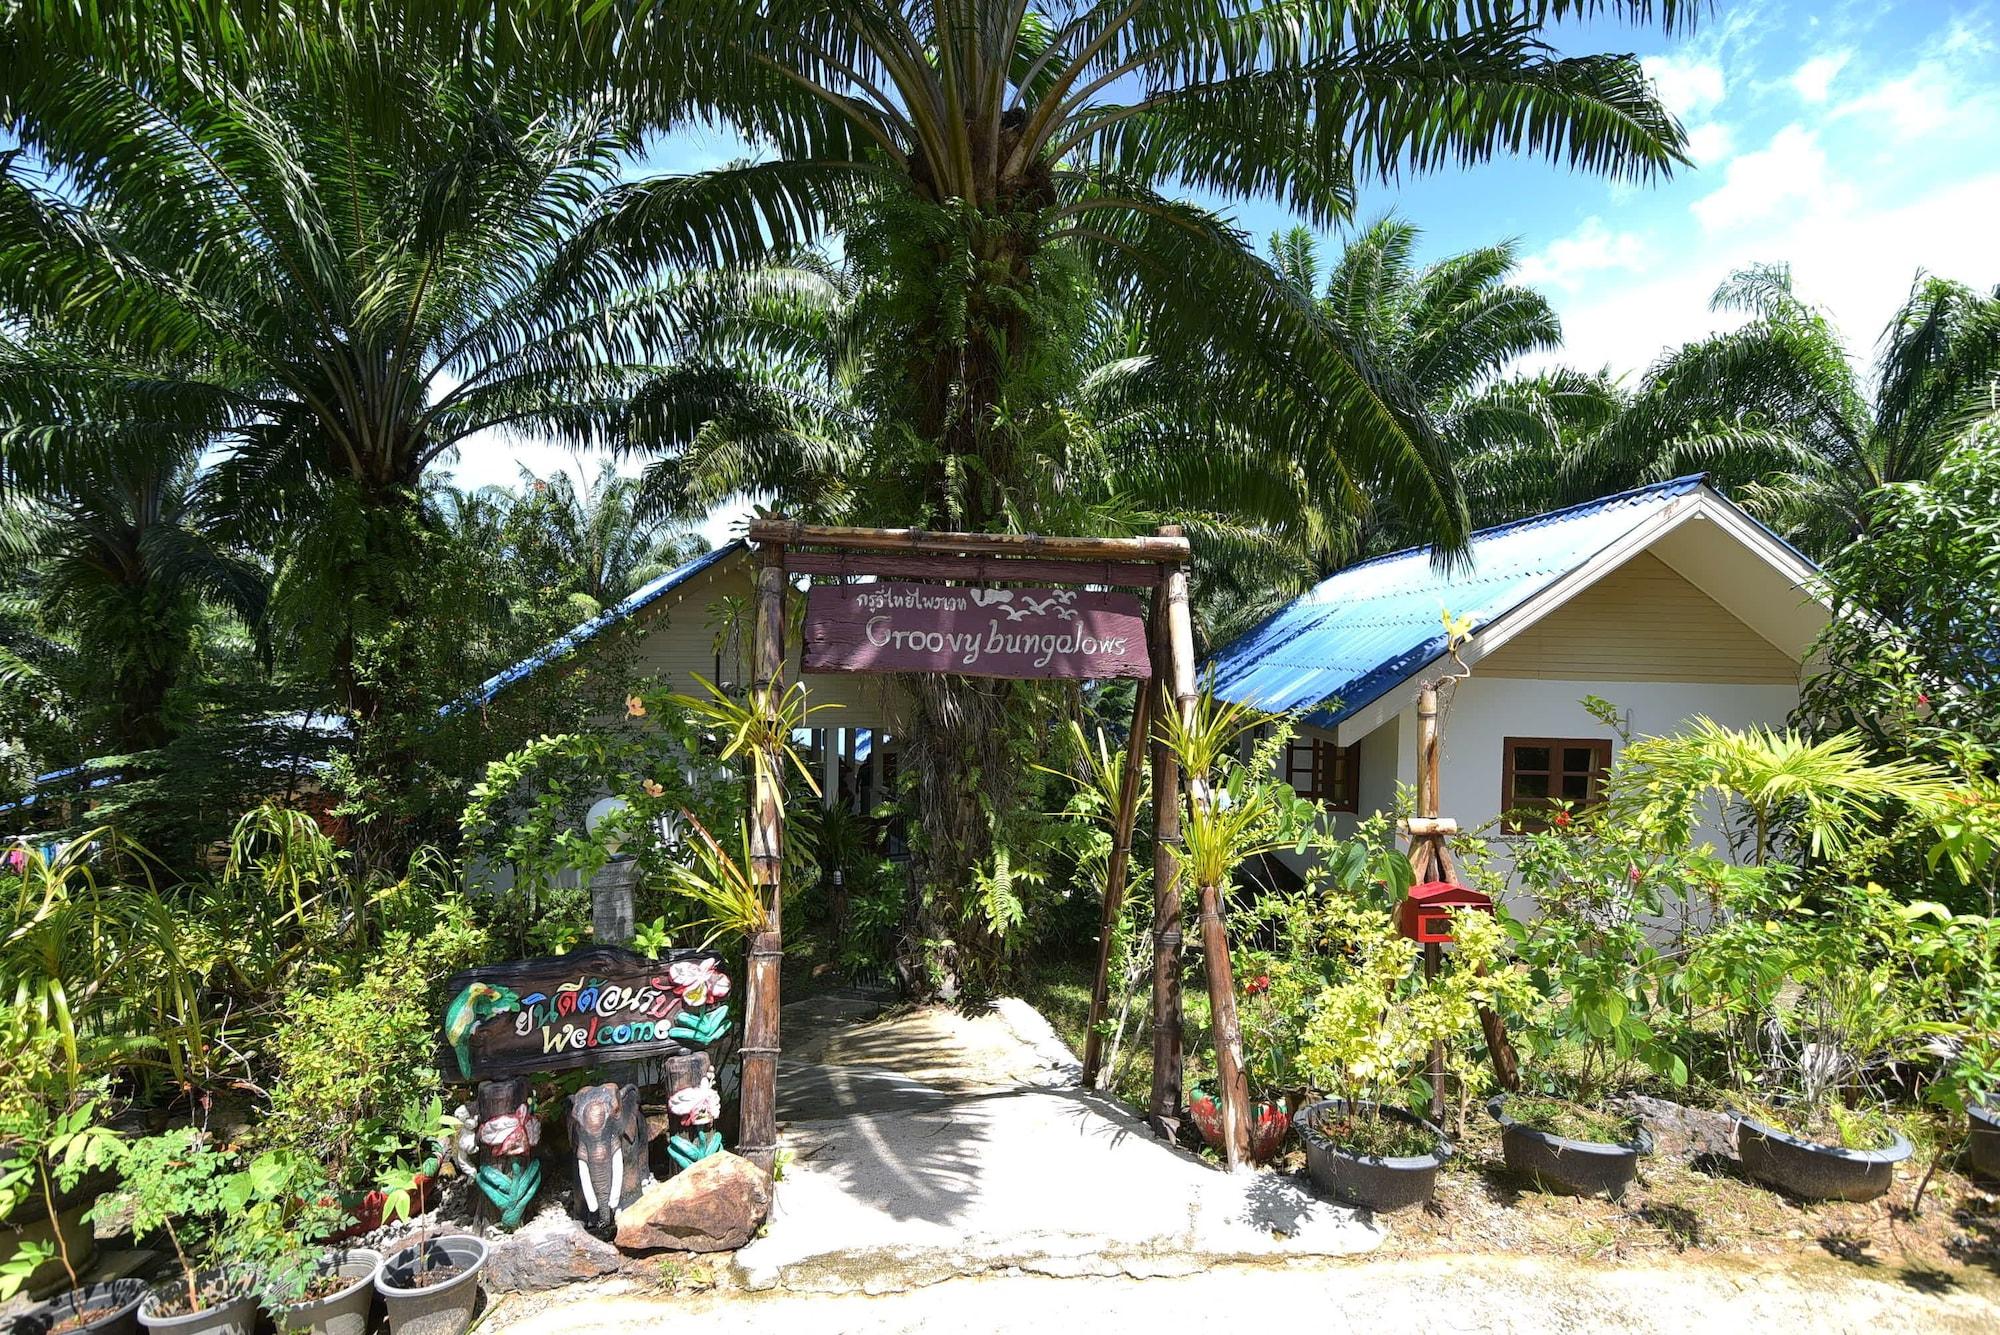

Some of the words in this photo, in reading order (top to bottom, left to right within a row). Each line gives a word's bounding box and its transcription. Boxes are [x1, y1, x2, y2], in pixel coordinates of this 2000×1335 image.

[865, 615, 982, 664] Groovy
[984, 619, 1128, 668] bungalows
[515, 976, 681, 1036] ยินดีต้อนรับ
[541, 1016, 672, 1054] Welcome
